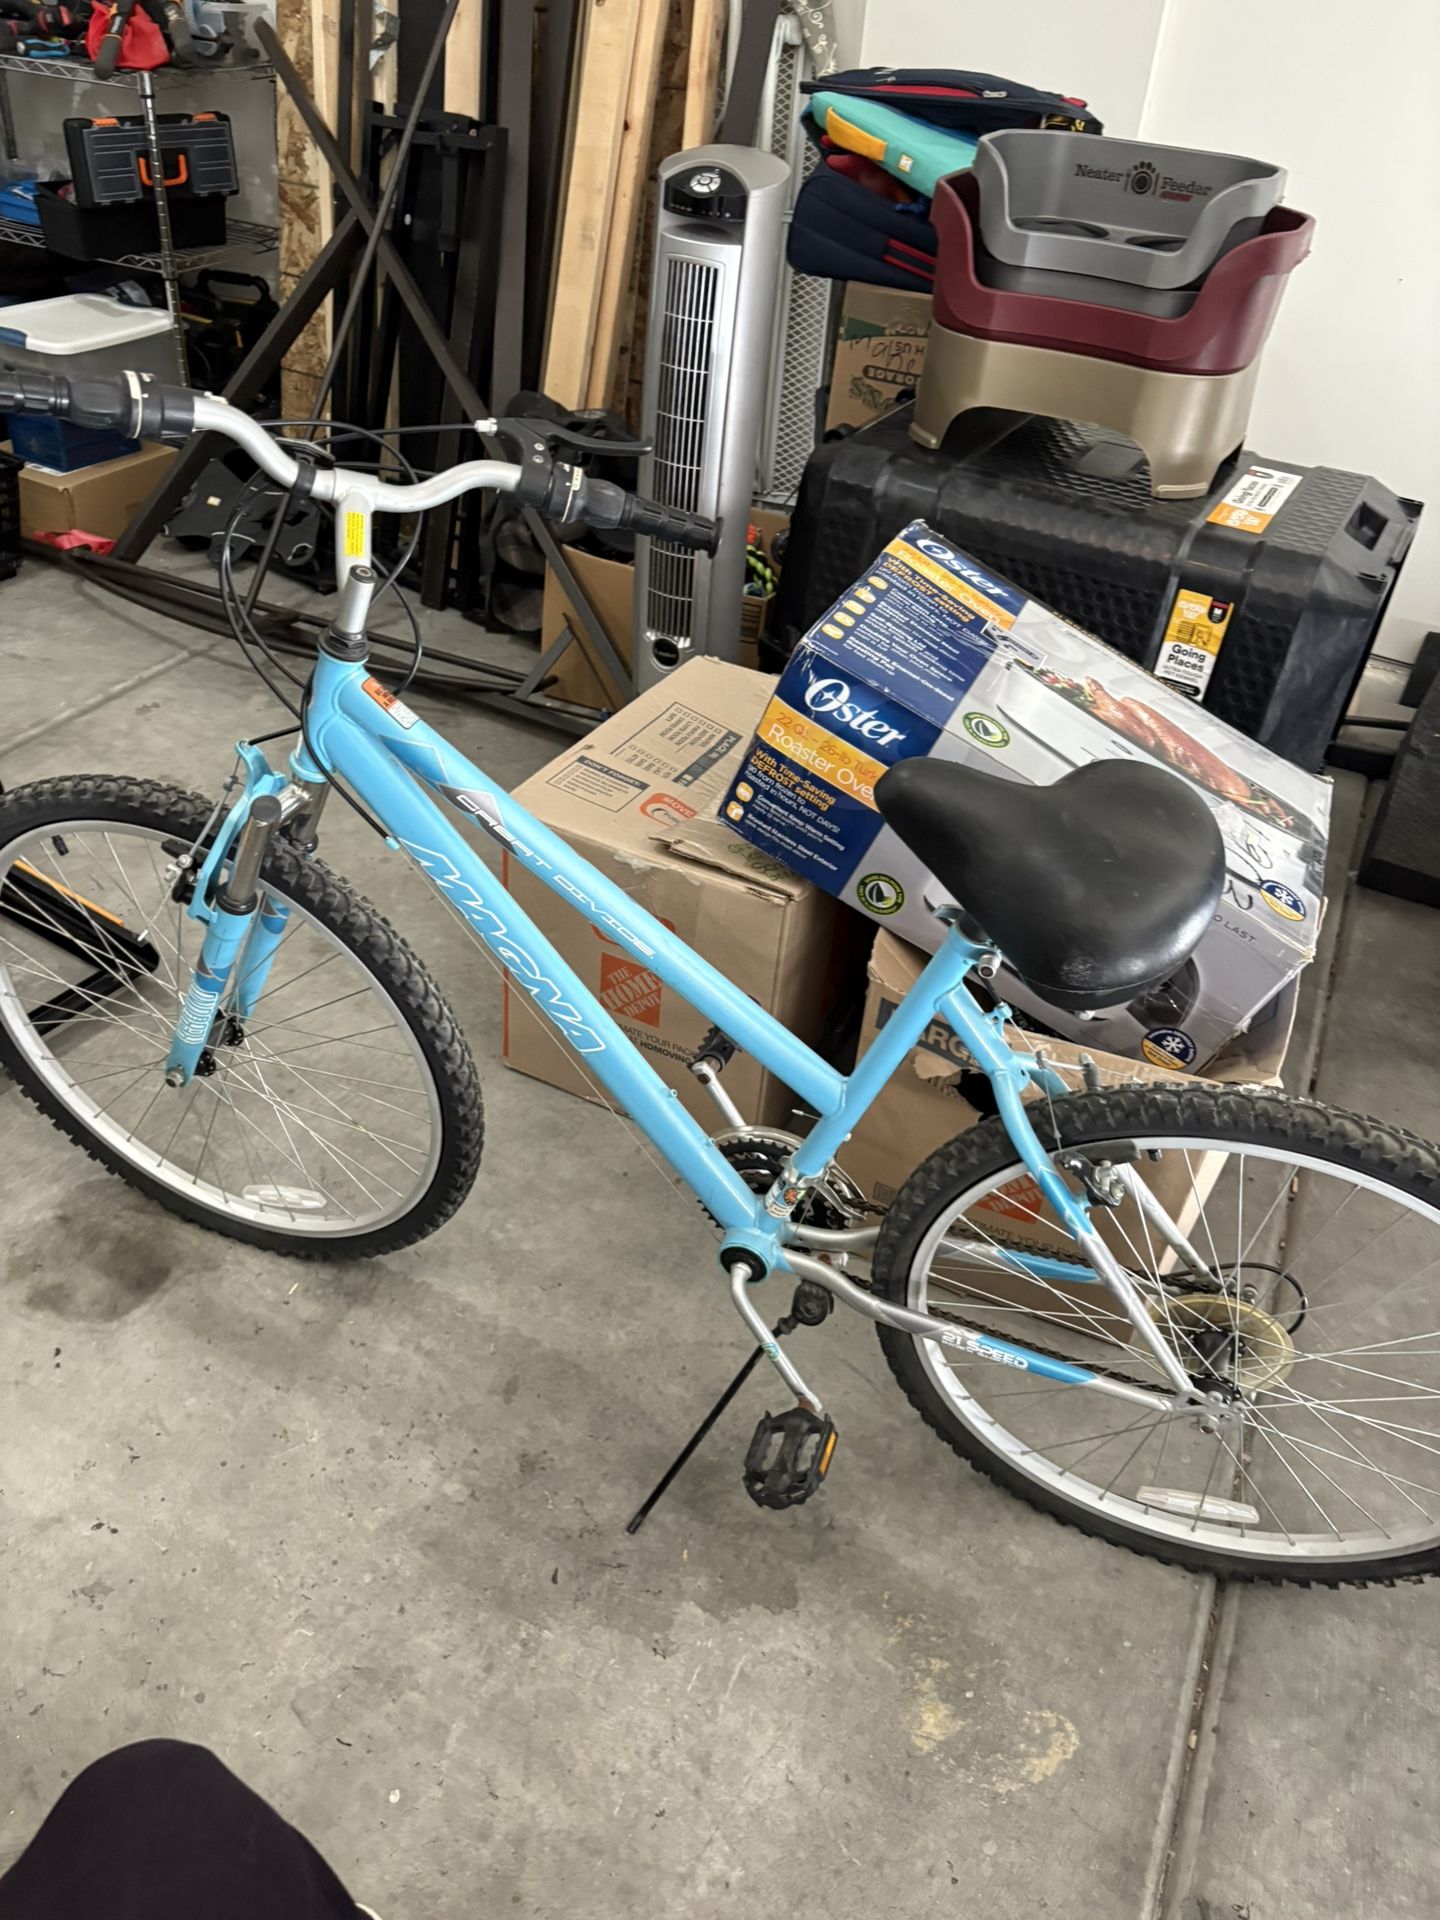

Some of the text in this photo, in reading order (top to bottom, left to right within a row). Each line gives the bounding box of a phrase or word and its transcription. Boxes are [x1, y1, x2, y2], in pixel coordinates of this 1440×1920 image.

[1073, 163, 1125, 183] Neater
[1160, 176, 1213, 196] Feeder
[916, 538, 1009, 598] Oster
[911, 576, 977, 619] Time-Saving
[932, 597, 970, 621] setting
[942, 614, 961, 627] NOT
[1166, 653, 1205, 673] Places
[1171, 643, 1207, 664] Going
[805, 679, 906, 746] Oster
[715, 734, 735, 753] PLACE
[767, 723, 837, 774] Roaster
[584, 760, 608, 771] DON'T
[747, 764, 806, 804] go from frozen to
[749, 757, 829, 811] DEFROST setting
[754, 748, 836, 804] With Time-Saving
[743, 771, 839, 833] roasted in hours, NOT DAYS!
[553, 873, 656, 959] DIVIDE
[394, 837, 607, 1054] MAGNA
[608, 965, 633, 985] THE
[623, 992, 661, 1017] DEPOT
[644, 1031, 673, 1048] YOUR
[941, 1330, 962, 1345] 21
[965, 1340, 1029, 1371] SPEED
